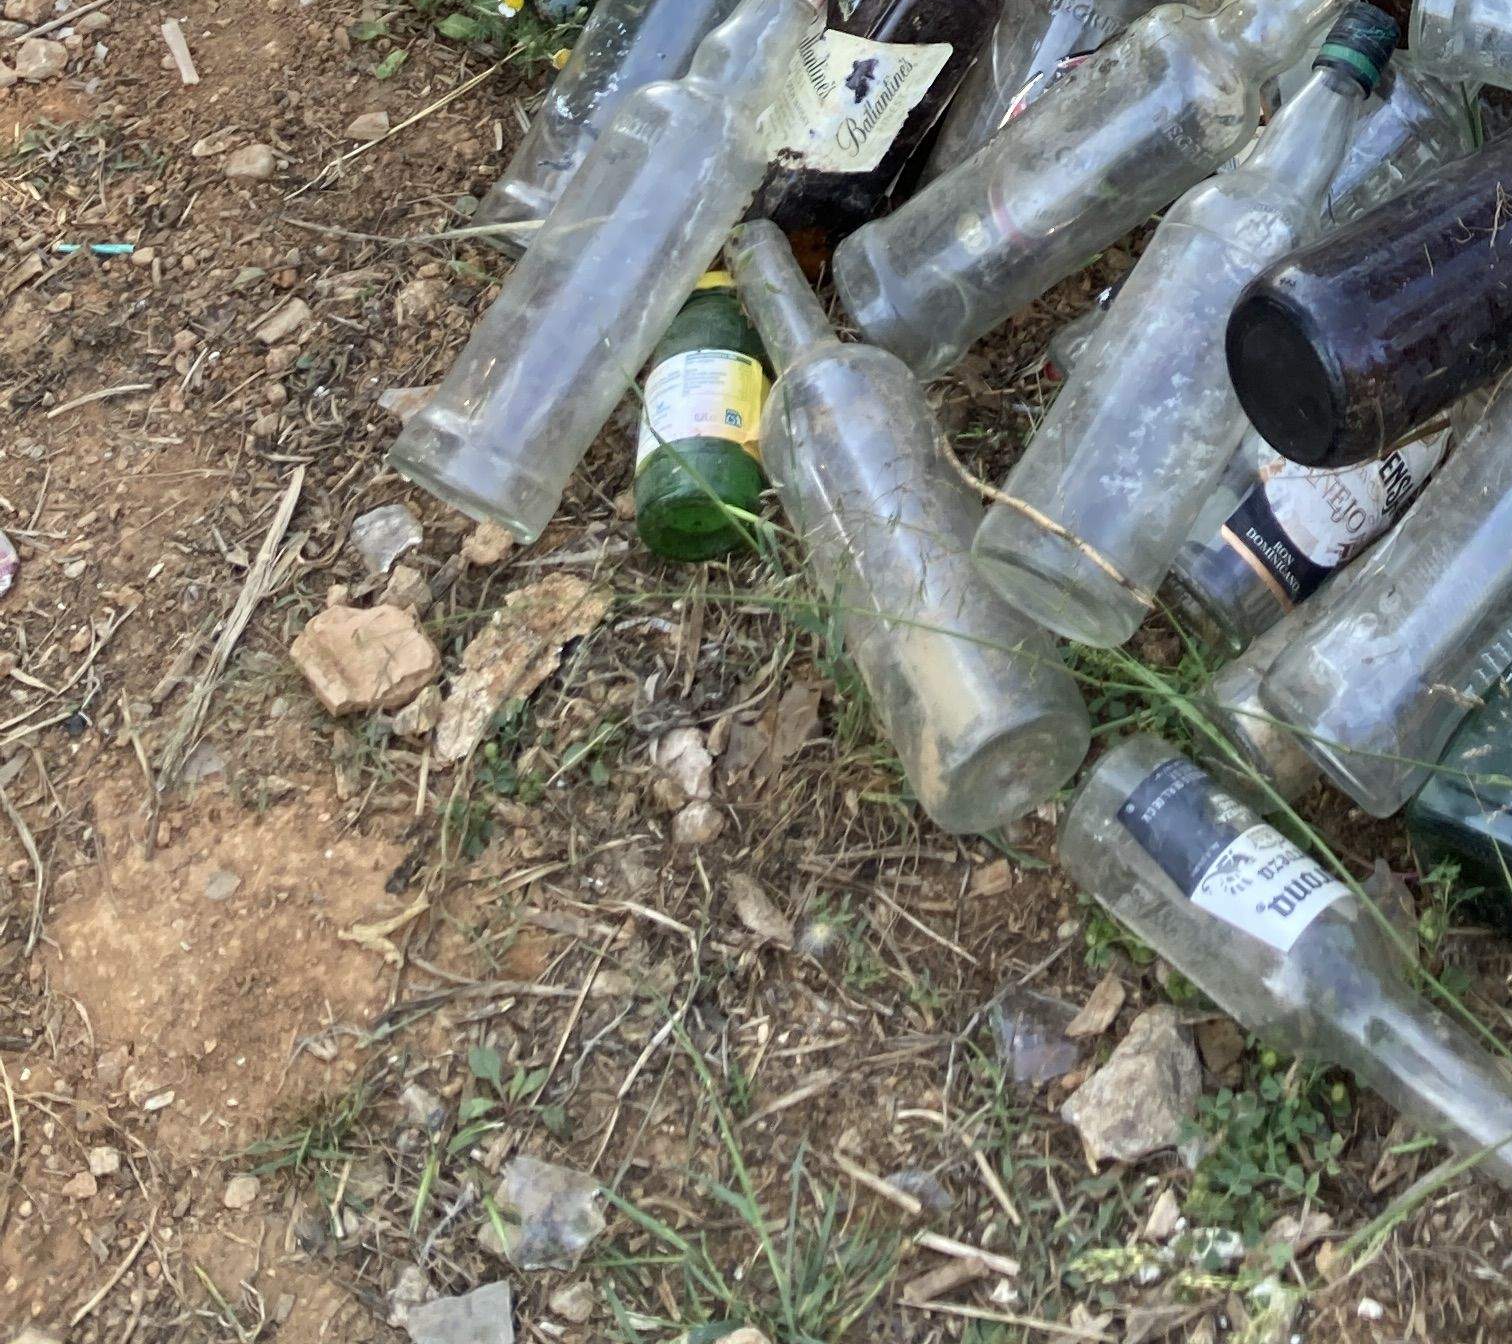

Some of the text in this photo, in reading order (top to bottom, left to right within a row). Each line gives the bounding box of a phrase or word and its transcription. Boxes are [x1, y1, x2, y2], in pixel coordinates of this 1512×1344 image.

[836, 58, 914, 158] Ballantine's
[1245, 526, 1301, 594] DOMINICANO
[1272, 540, 1296, 567] RON
